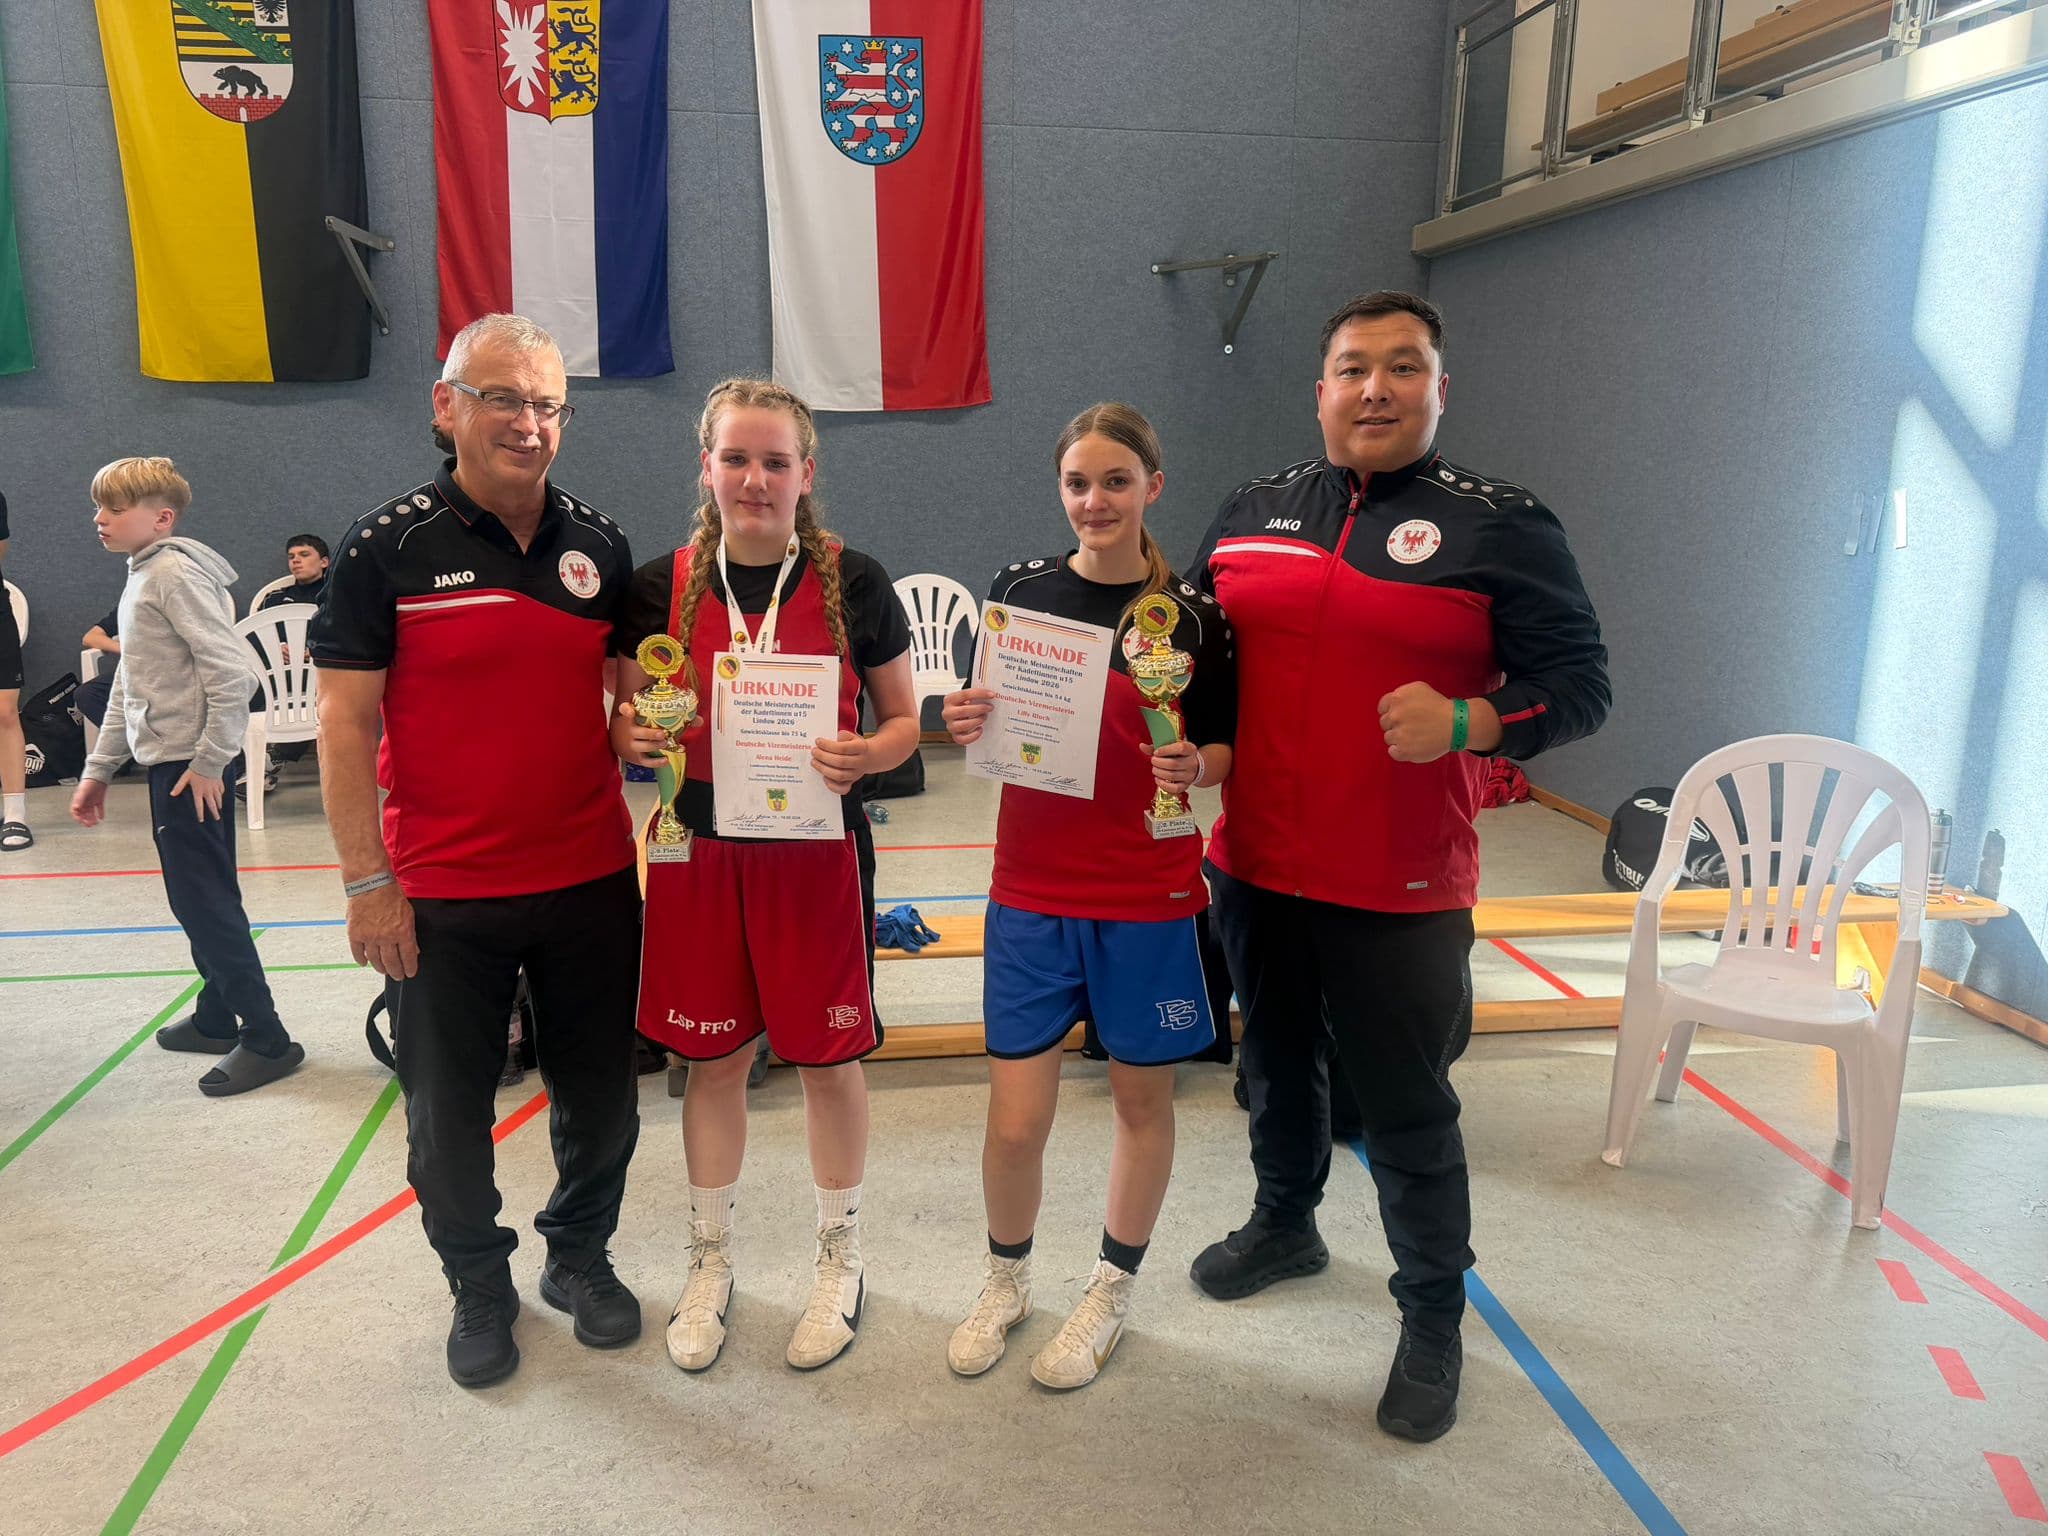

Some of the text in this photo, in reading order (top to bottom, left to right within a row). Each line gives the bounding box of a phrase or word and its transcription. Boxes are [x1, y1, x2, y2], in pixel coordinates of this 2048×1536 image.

[1265, 518, 1301, 532] JAKO
[434, 571, 475, 588] JAKO
[997, 633, 1088, 666] URKUNDE
[998, 652, 1083, 677] Deutsche Meisterschaften
[1004, 663, 1073, 684] der Kadettinnen u15
[1016, 674, 1039, 684] Lindow
[731, 681, 818, 697] URKUNDE
[765, 701, 815, 709] Meisterschaften
[995, 692, 1026, 704] Deutsche
[753, 709, 792, 717] Kadettinnen
[736, 740, 765, 748] Deutsche
[666, 1008, 736, 1034] LSP FFO
